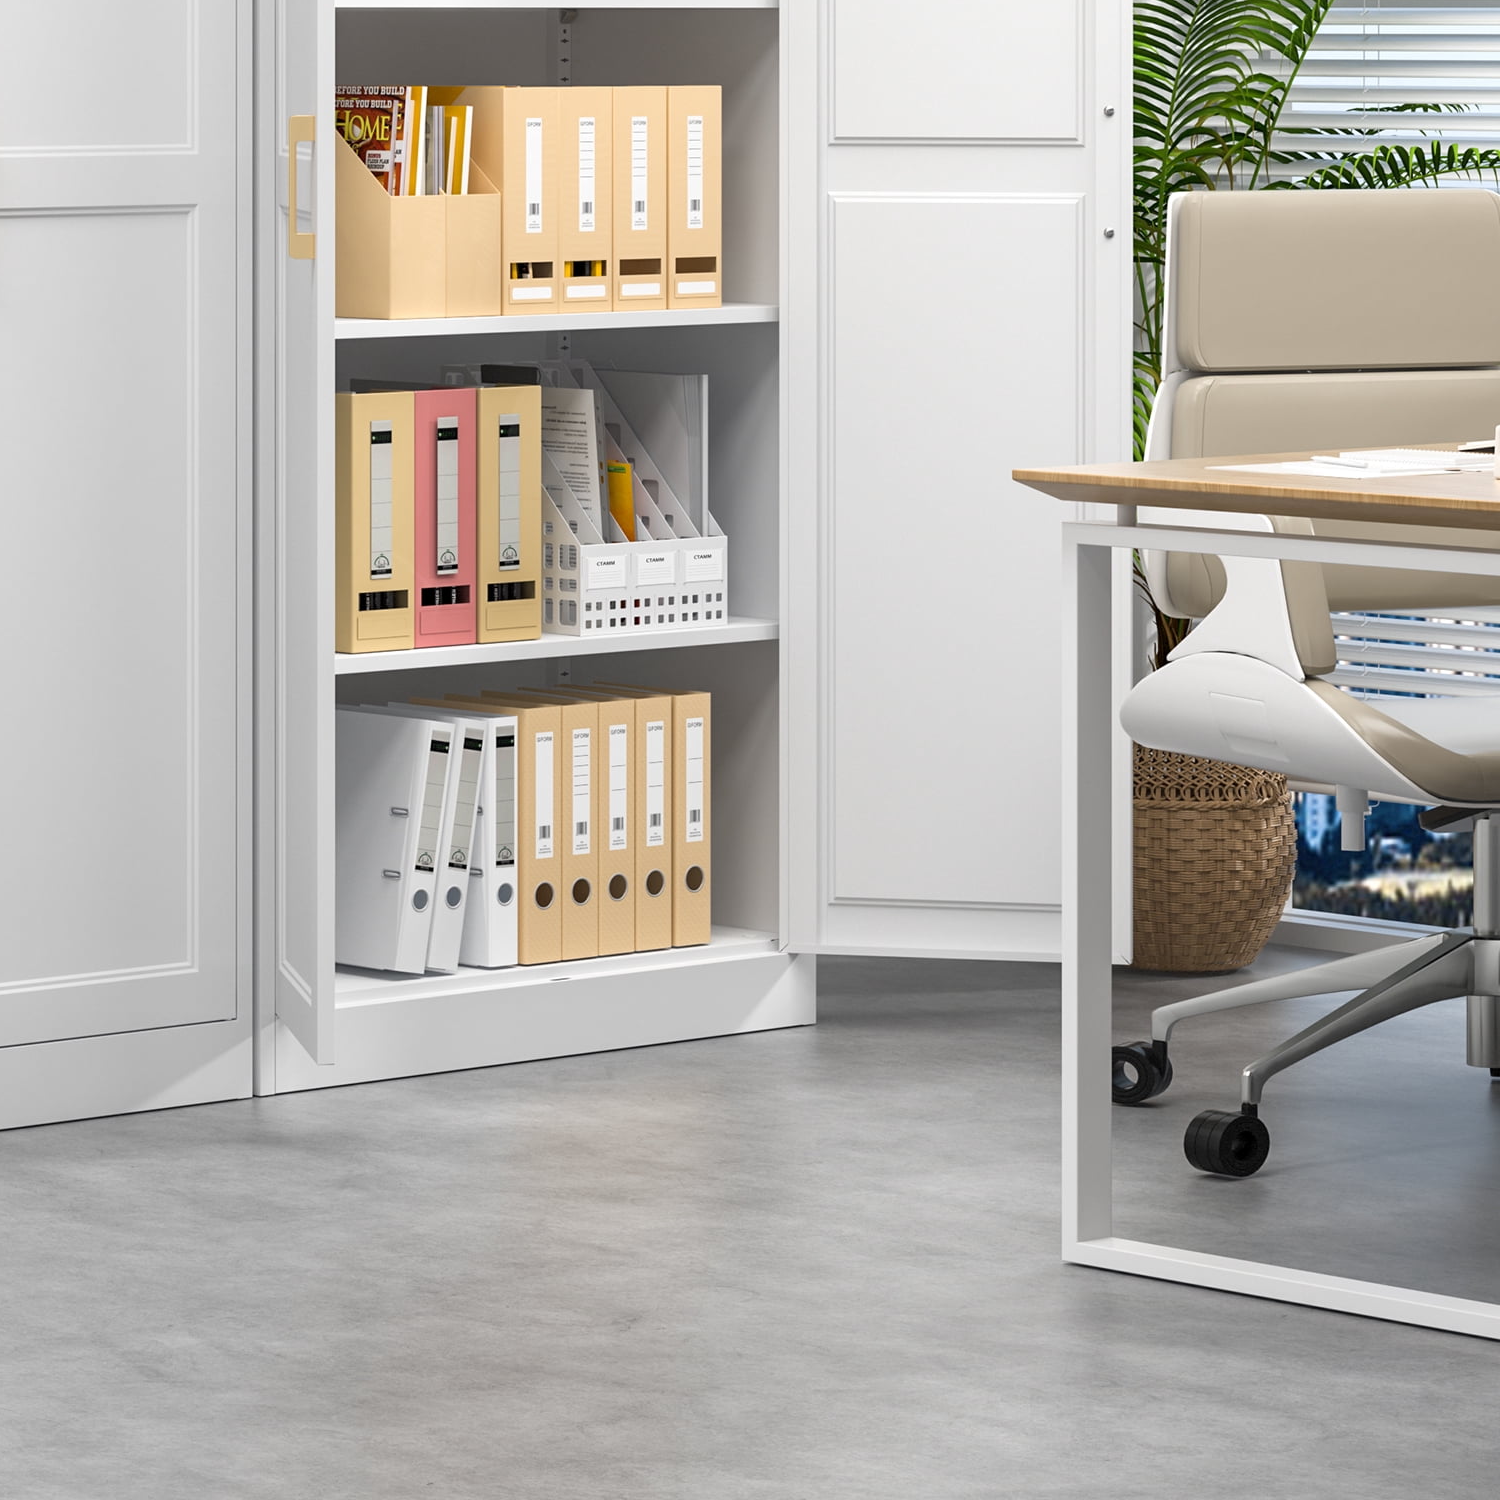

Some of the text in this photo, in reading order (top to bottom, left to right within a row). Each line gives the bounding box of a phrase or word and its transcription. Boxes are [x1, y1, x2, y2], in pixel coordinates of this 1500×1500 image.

[336, 86, 405, 96] EFORE YOU BUILD
[336, 99, 392, 109] FORE YOU BUILD
[335, 110, 391, 141] HOME
